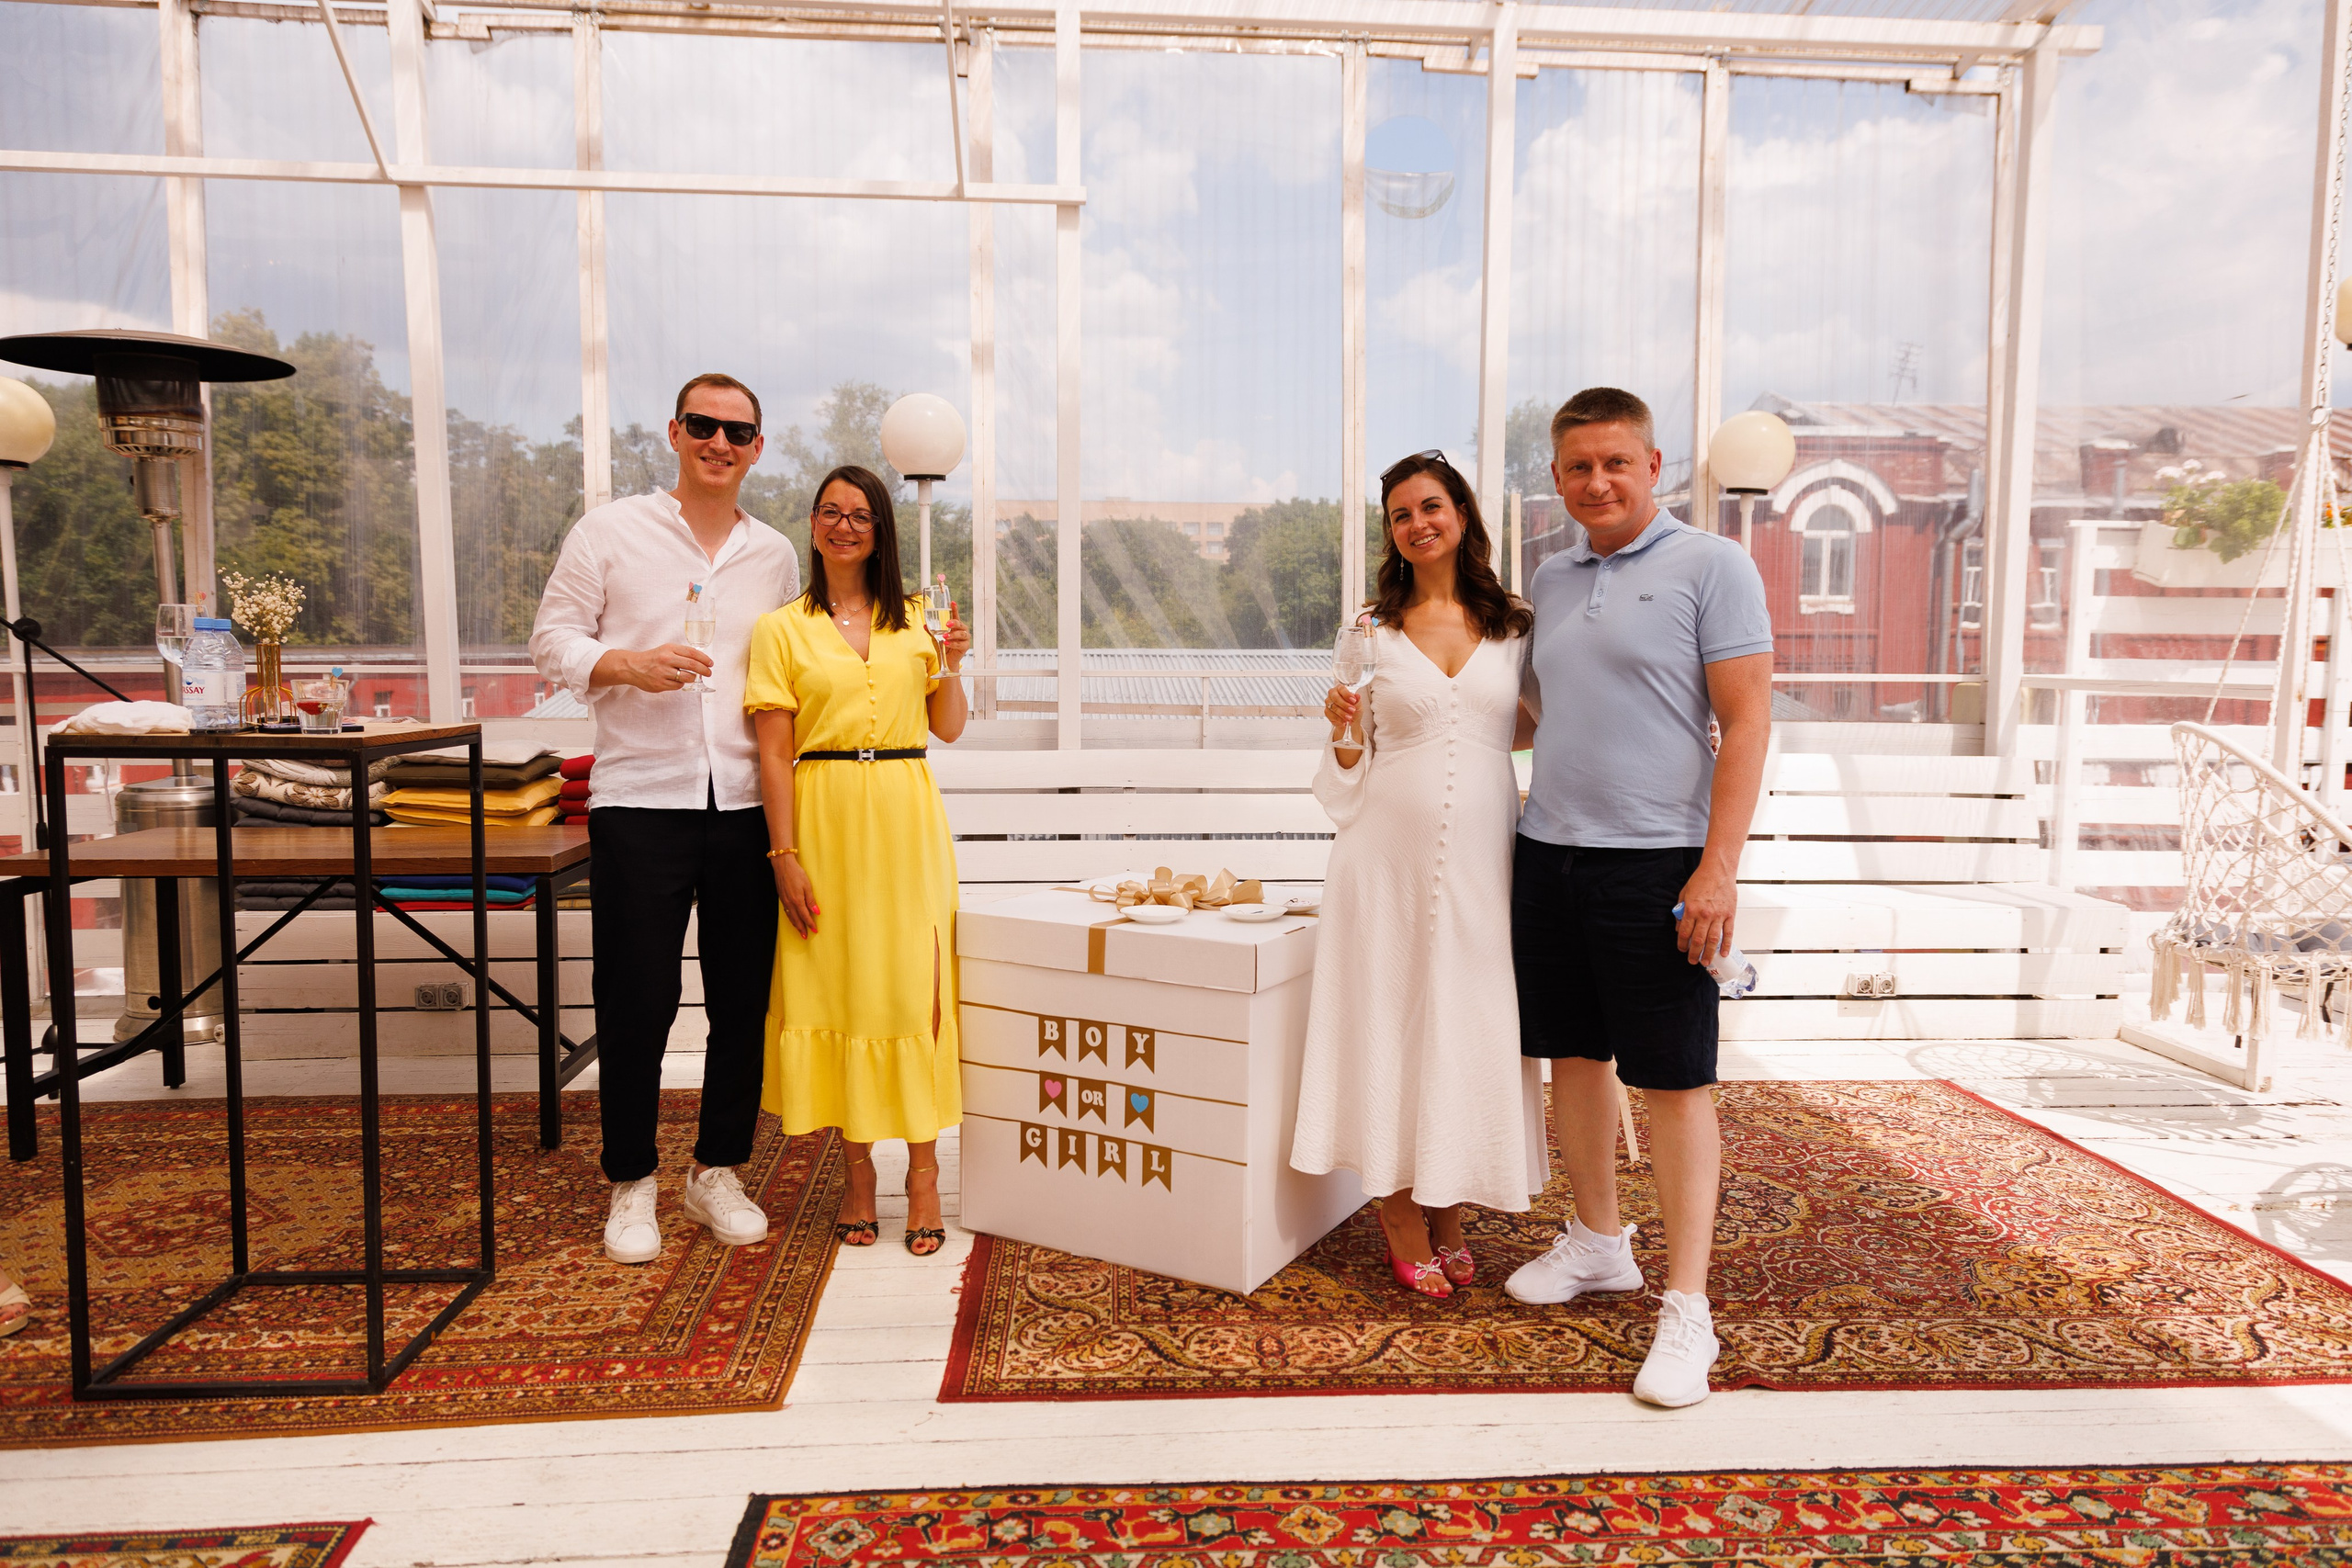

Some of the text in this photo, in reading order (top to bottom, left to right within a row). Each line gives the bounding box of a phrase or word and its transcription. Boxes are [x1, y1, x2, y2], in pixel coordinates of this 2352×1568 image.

[1044, 1020, 1149, 1054] BOY
[1081, 1089, 1104, 1107] OR
[1025, 1127, 1165, 1173] GIRL
